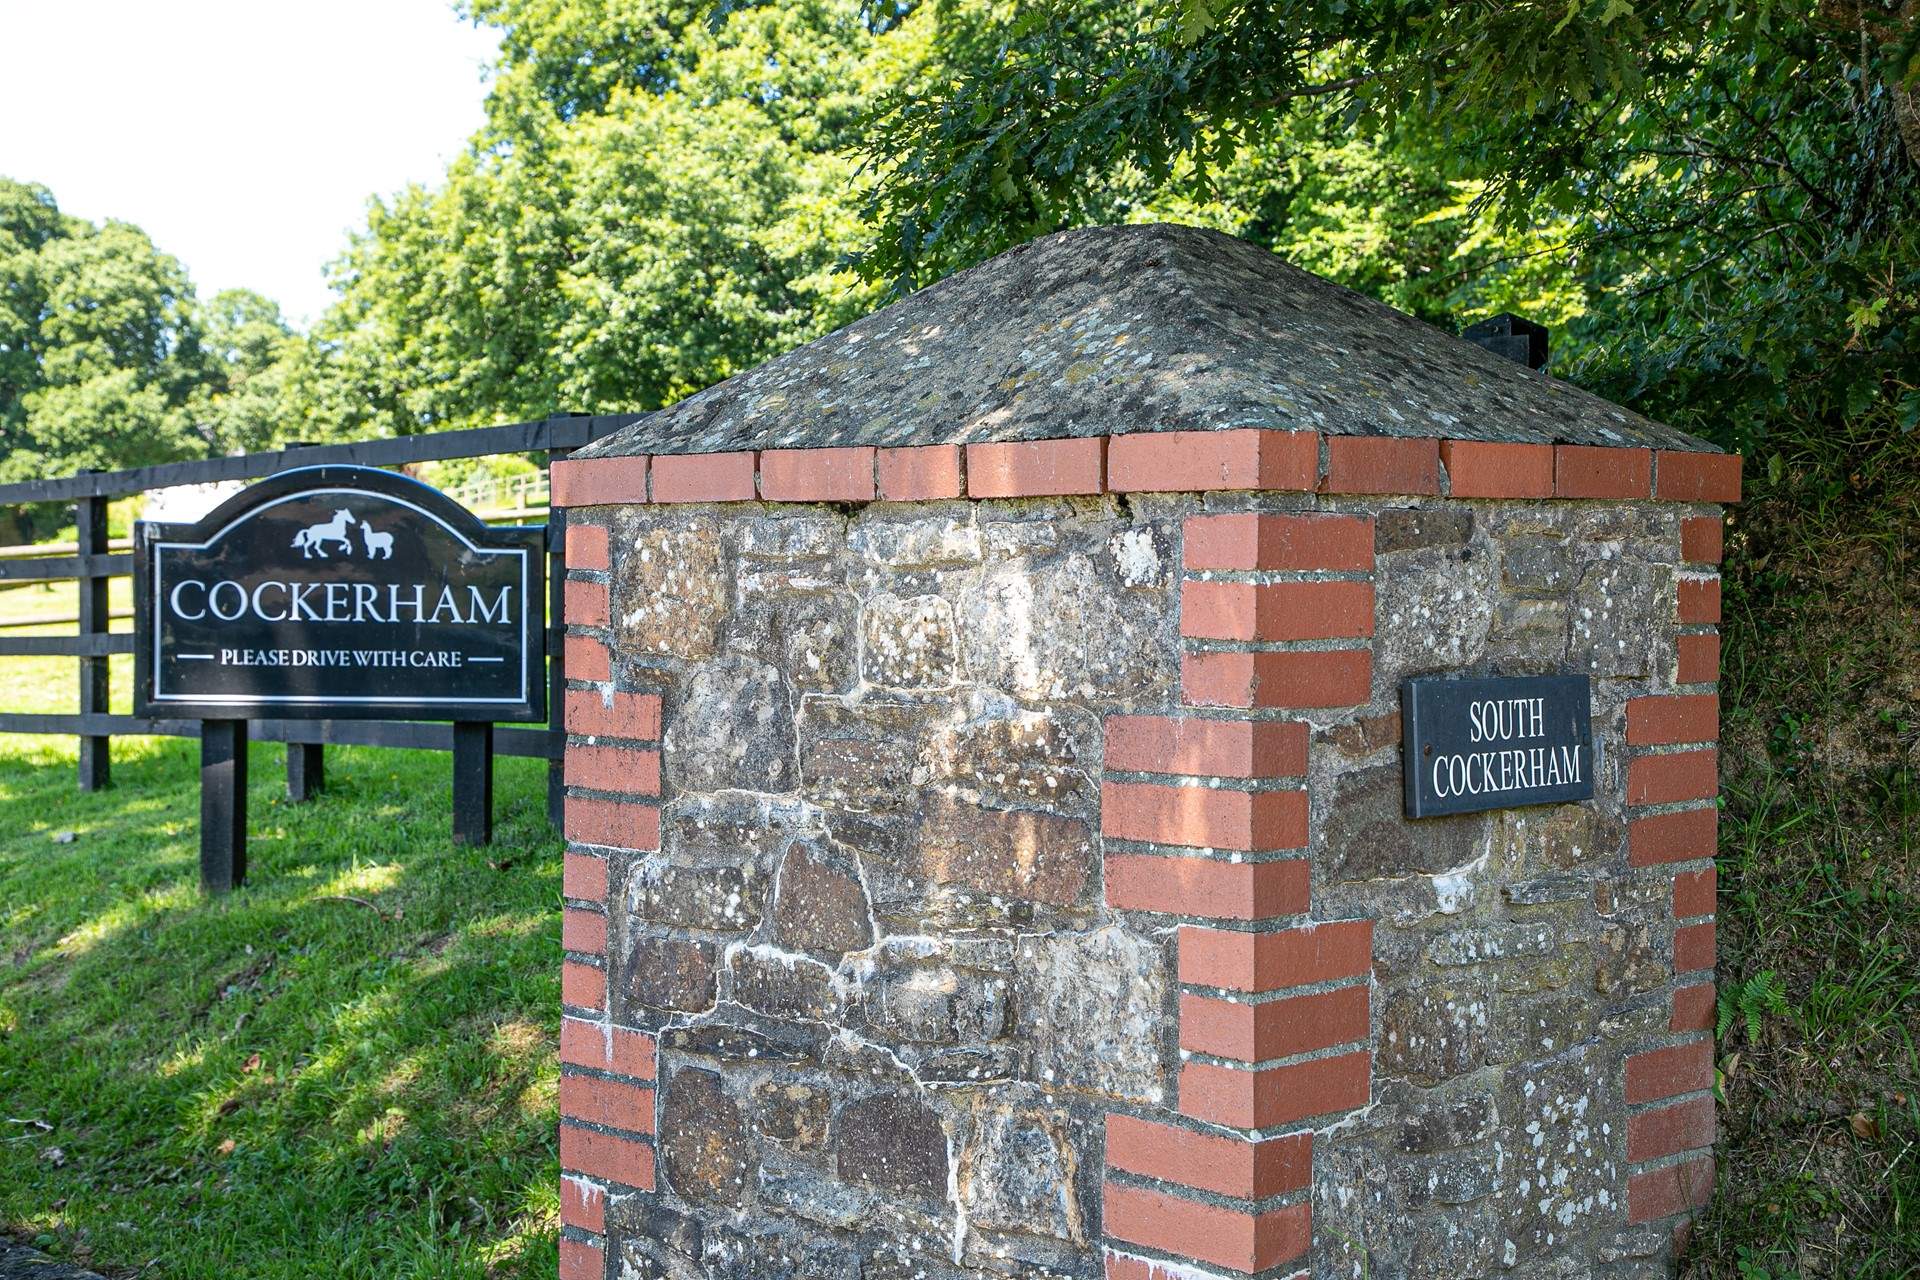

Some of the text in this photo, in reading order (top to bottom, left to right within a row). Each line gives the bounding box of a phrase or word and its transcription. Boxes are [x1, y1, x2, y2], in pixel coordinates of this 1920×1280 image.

[170, 579, 512, 624] COCKERHAM
[220, 648, 462, 667] PLEASE DRIVE WITH CARE
[1469, 697, 1545, 743] SOUTH
[1432, 744, 1582, 798] COCKERHAM
